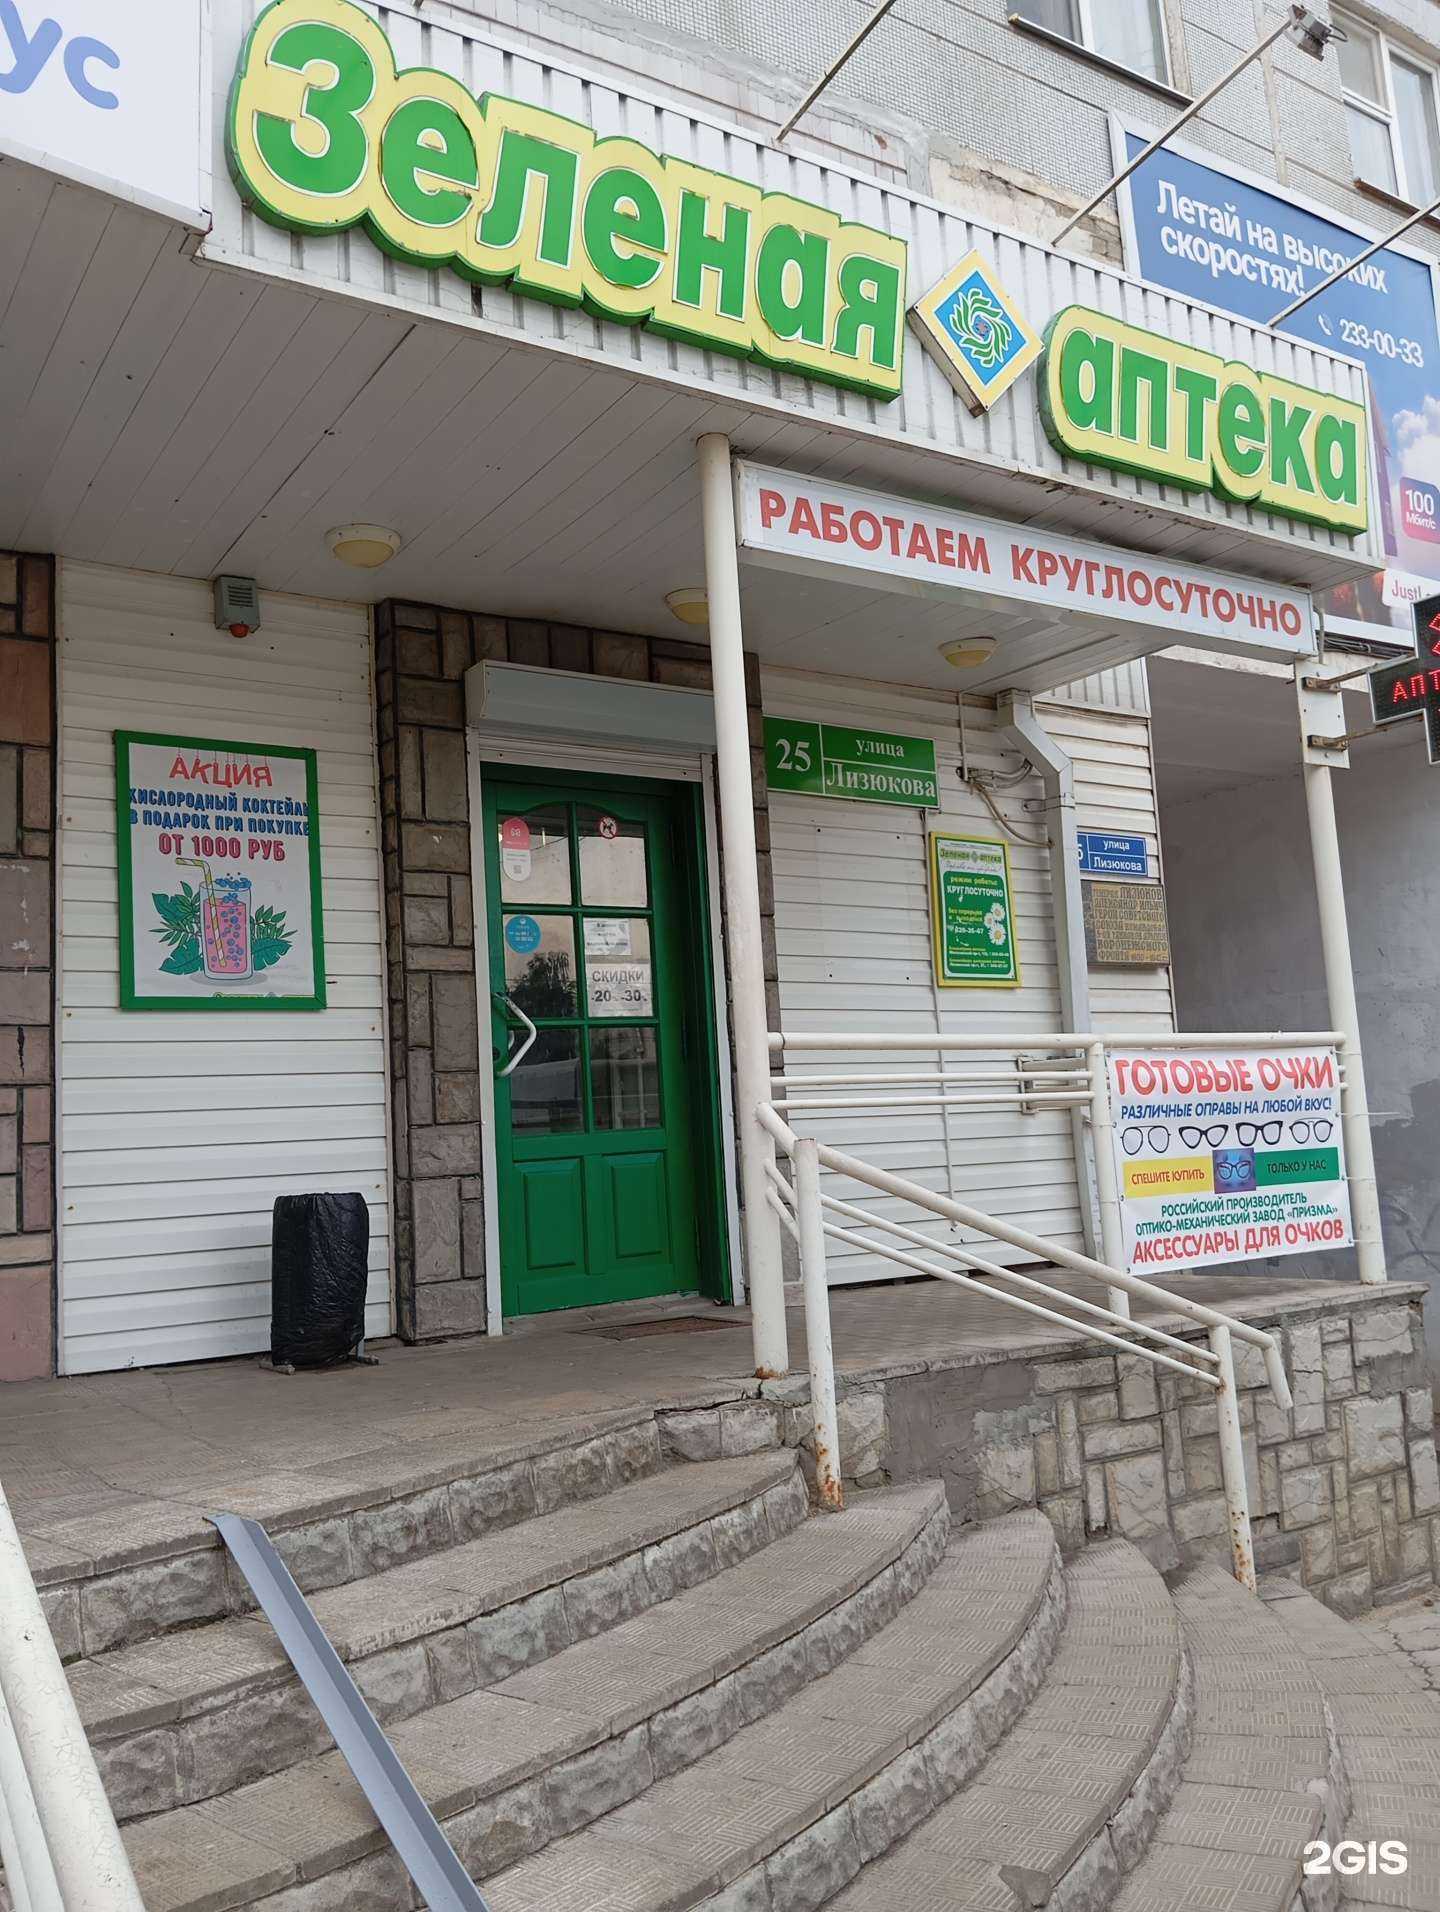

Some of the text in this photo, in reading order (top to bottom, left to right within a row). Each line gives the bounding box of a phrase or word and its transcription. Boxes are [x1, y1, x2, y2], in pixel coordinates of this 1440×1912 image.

[1157, 179, 1388, 294] Летай на высоких
[253, 20, 1359, 507] Зеленая аптека
[1160, 225, 1307, 297] скоростях!
[1338, 318, 1424, 368] 233-00-33
[1405, 489, 1435, 516] 100
[1406, 511, 1437, 530] Мбит/с
[759, 488, 1302, 637] РАБОТАЕМ КРУГЛОСУТОЧНО
[776, 738, 811, 772] 25
[856, 738, 904, 758] улица
[169, 756, 273, 788] АКЦИЯ
[827, 763, 936, 798] Лизюкова
[130, 788, 237, 812] КИСЛОРОДНЫЙ
[143, 810, 211, 831] ПОДАРОК
[214, 814, 243, 832] ПРИ
[249, 818, 310, 836] ПОКУПКЕ
[159, 832, 286, 863] ОТ 1000 РУБ
[1103, 839, 1130, 852] улица
[1093, 856, 1142, 871] Лизюкова
[946, 885, 1004, 898] КРУГЛОСУТОЧНО
[592, 970, 645, 985] СКИДКИ
[1115, 1056, 1333, 1096] ГОТОВЫЕ ОЧКИ
[1121, 1095, 1332, 1120] РАЗЛИЧНЫЕ ОПРАВЫ НА ЛЮБОЙ ВКУС!
[1131, 1168, 1205, 1185] СПЕШИТЕ КУПИТЬ
[1267, 1159, 1327, 1174] ТОЛЬКО У НАС
[1161, 1192, 1307, 1217] РОССИЙСКИЙ ПРОИЗВОДИТЕЛЬ
[1135, 1203, 1338, 1236] ОПТИКО-МЕХАНИЧЕСКИЙ ЗАВОД «ПРИЗМА»
[1132, 1218, 1345, 1264] АКСЕССУАРЫ ДЛЯ ОЧКОВ
